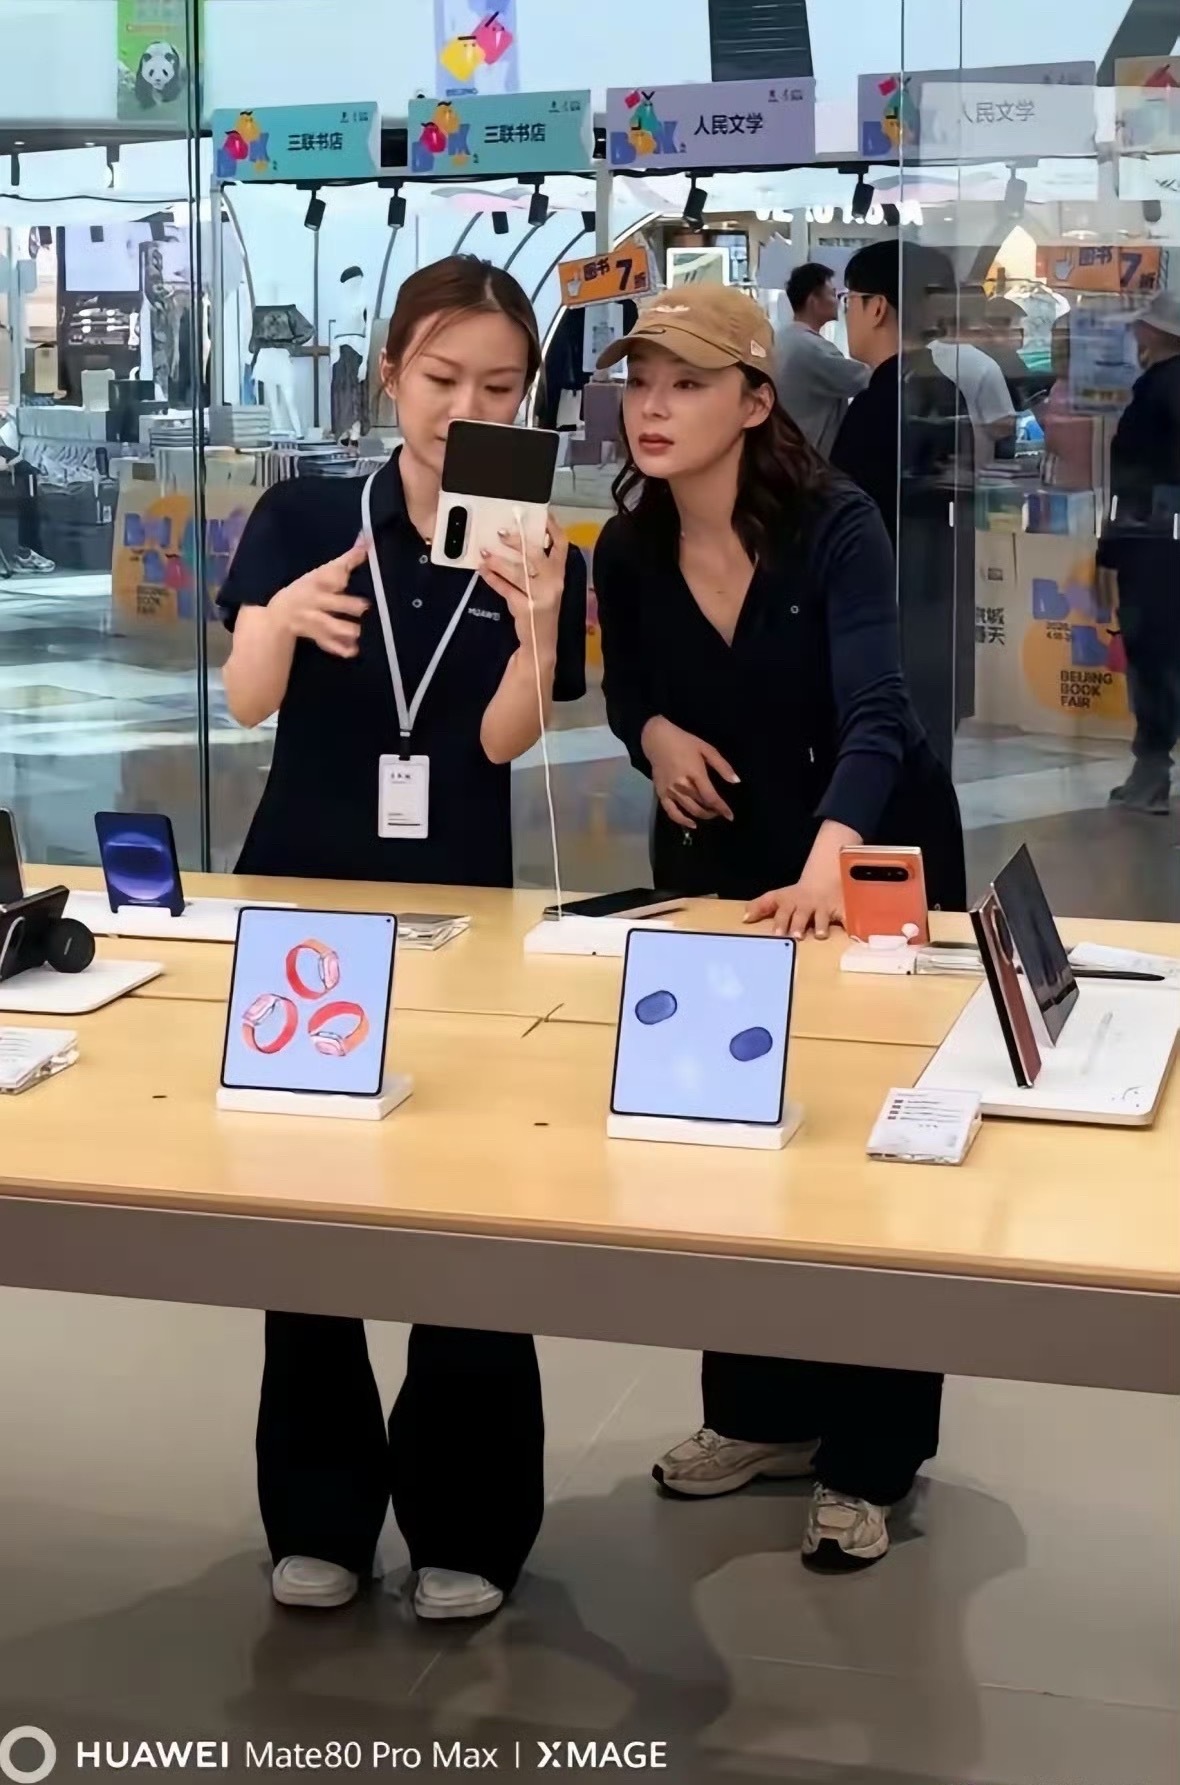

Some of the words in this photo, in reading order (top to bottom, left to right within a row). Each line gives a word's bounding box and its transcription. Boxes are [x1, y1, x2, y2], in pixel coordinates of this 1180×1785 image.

[484, 123, 546, 144] 三联书店
[693, 113, 764, 136] 人民文学
[287, 132, 343, 151] 三联书店
[1060, 683, 1101, 697] BOOK
[1060, 695, 1091, 709] FAIR
